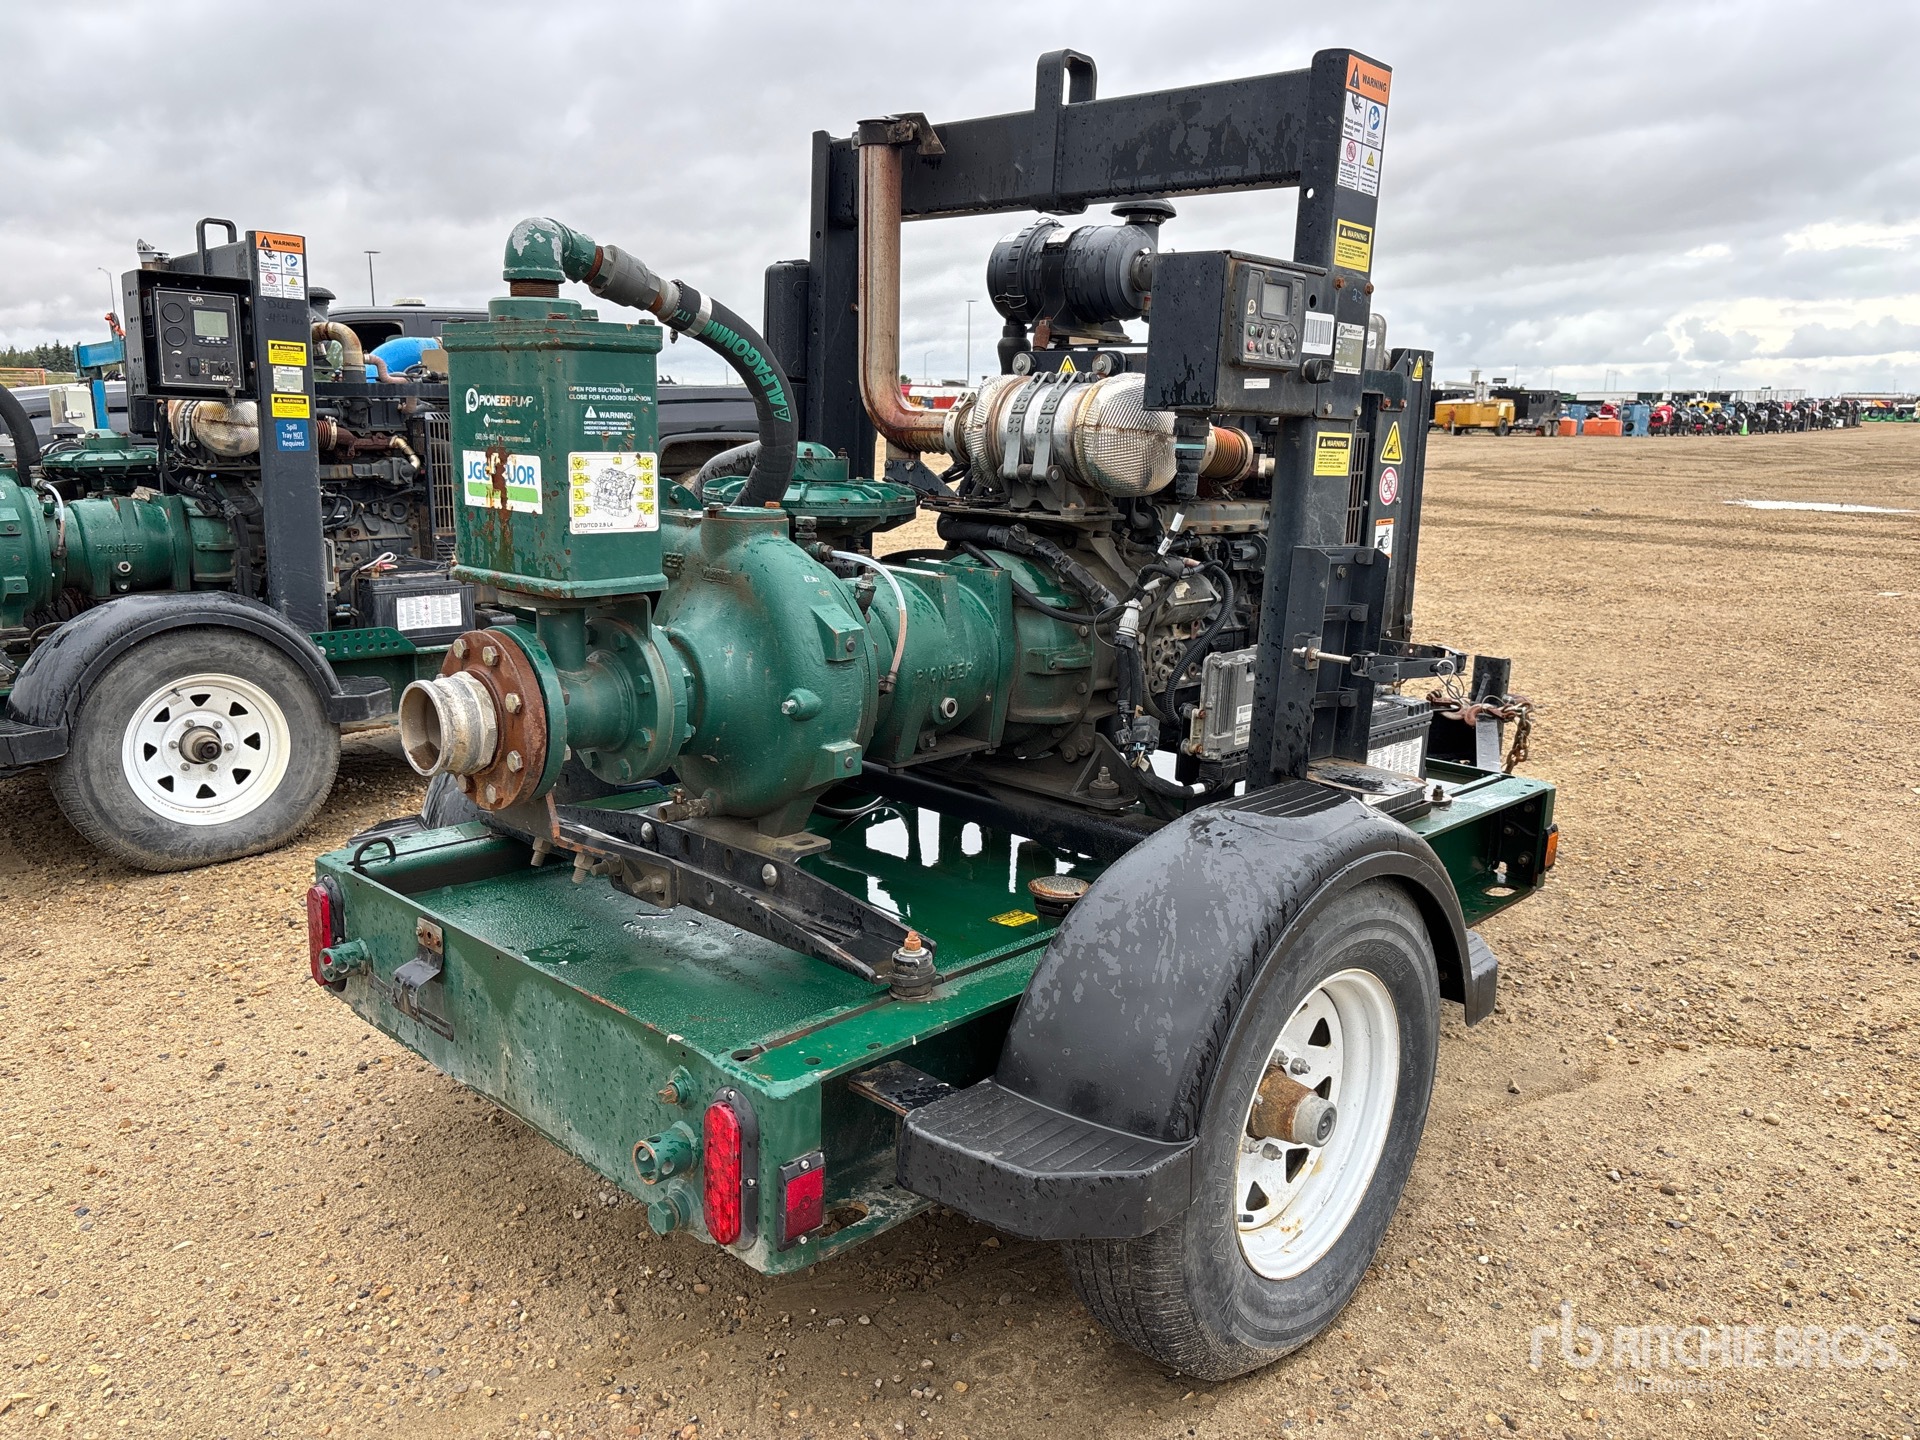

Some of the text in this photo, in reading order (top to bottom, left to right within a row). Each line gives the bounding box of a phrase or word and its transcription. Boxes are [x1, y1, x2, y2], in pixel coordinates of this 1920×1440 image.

[1362, 73, 1387, 92] WARNING
[1347, 230, 1367, 241] WARNING
[272, 239, 301, 248] WARNING
[701, 319, 788, 406] ALFAGOMM
[285, 423, 298, 431] Spill
[281, 431, 292, 439] Tray
[281, 440, 305, 448] Required
[1327, 440, 1347, 448] WARNING
[96, 543, 143, 554] PIONEER
[916, 662, 974, 683] PIONEER
